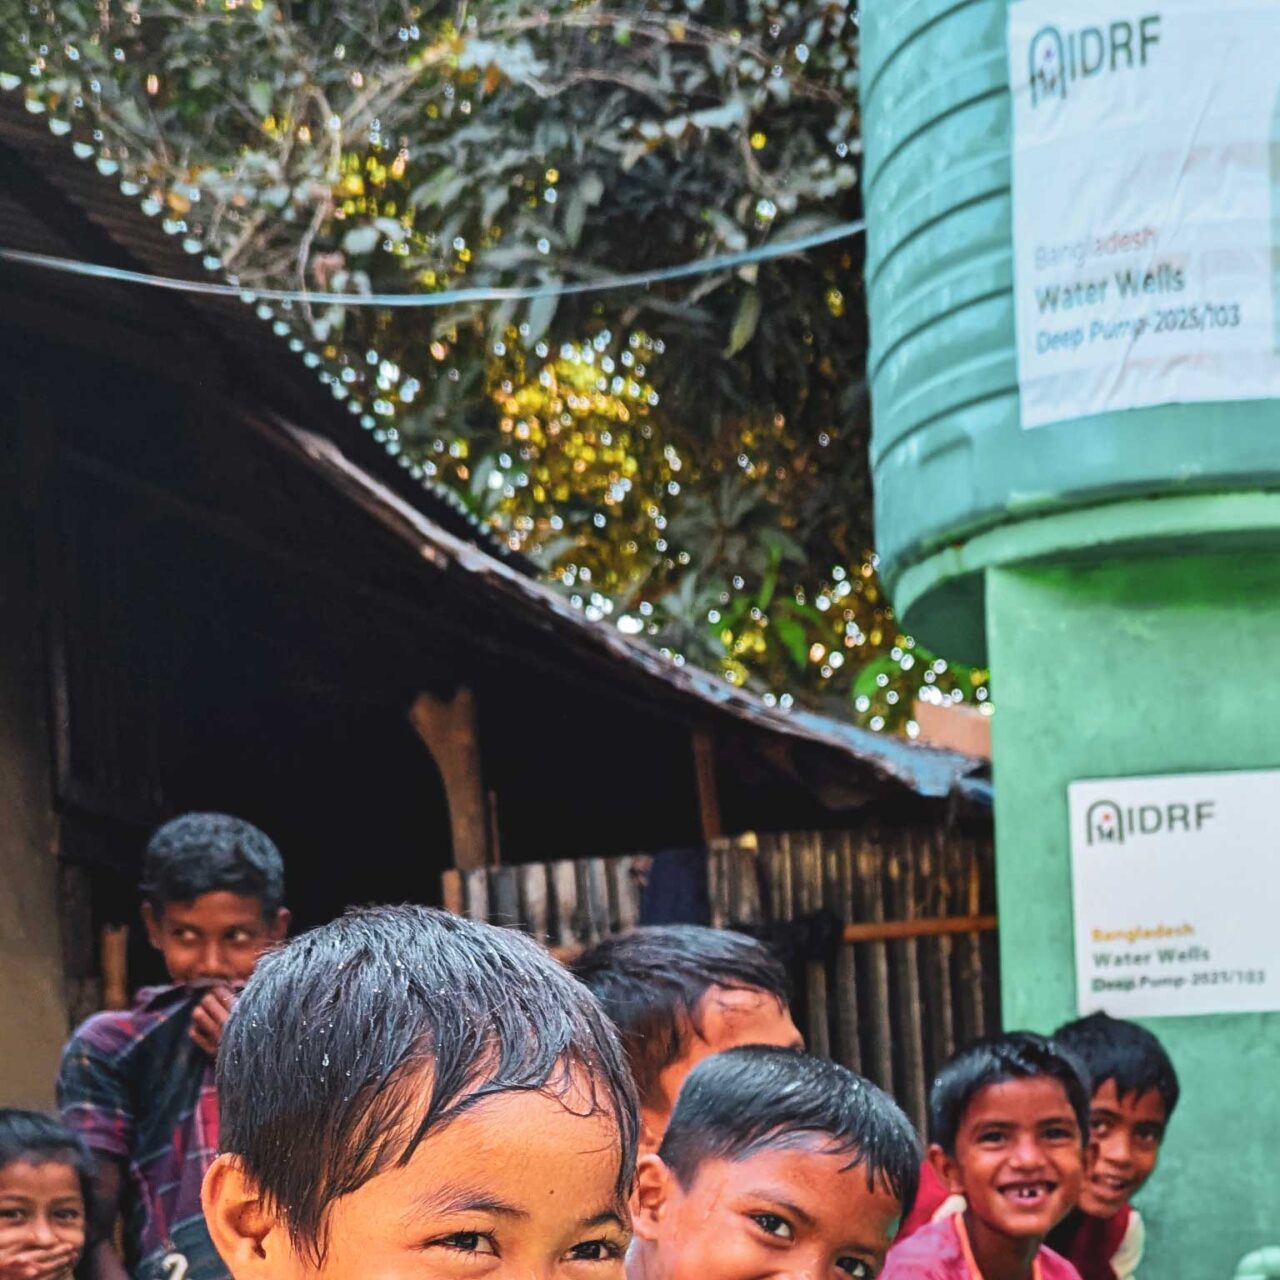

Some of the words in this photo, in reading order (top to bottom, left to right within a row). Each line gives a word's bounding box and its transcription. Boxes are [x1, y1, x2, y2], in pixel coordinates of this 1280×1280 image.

[1068, 14, 1160, 82] IDRF
[1035, 276, 1109, 314] Water
[1115, 262, 1185, 299] Wells
[1036, 325, 1085, 355] Deep
[1090, 317, 1148, 342] Pump
[1127, 800, 1216, 835] IDRF
[1091, 922, 1194, 943] Bangladesh
[1092, 952, 1151, 968] Water
[1157, 946, 1210, 964] Wells
[1092, 976, 1136, 993] Deep
[1140, 975, 1186, 990] Pump
